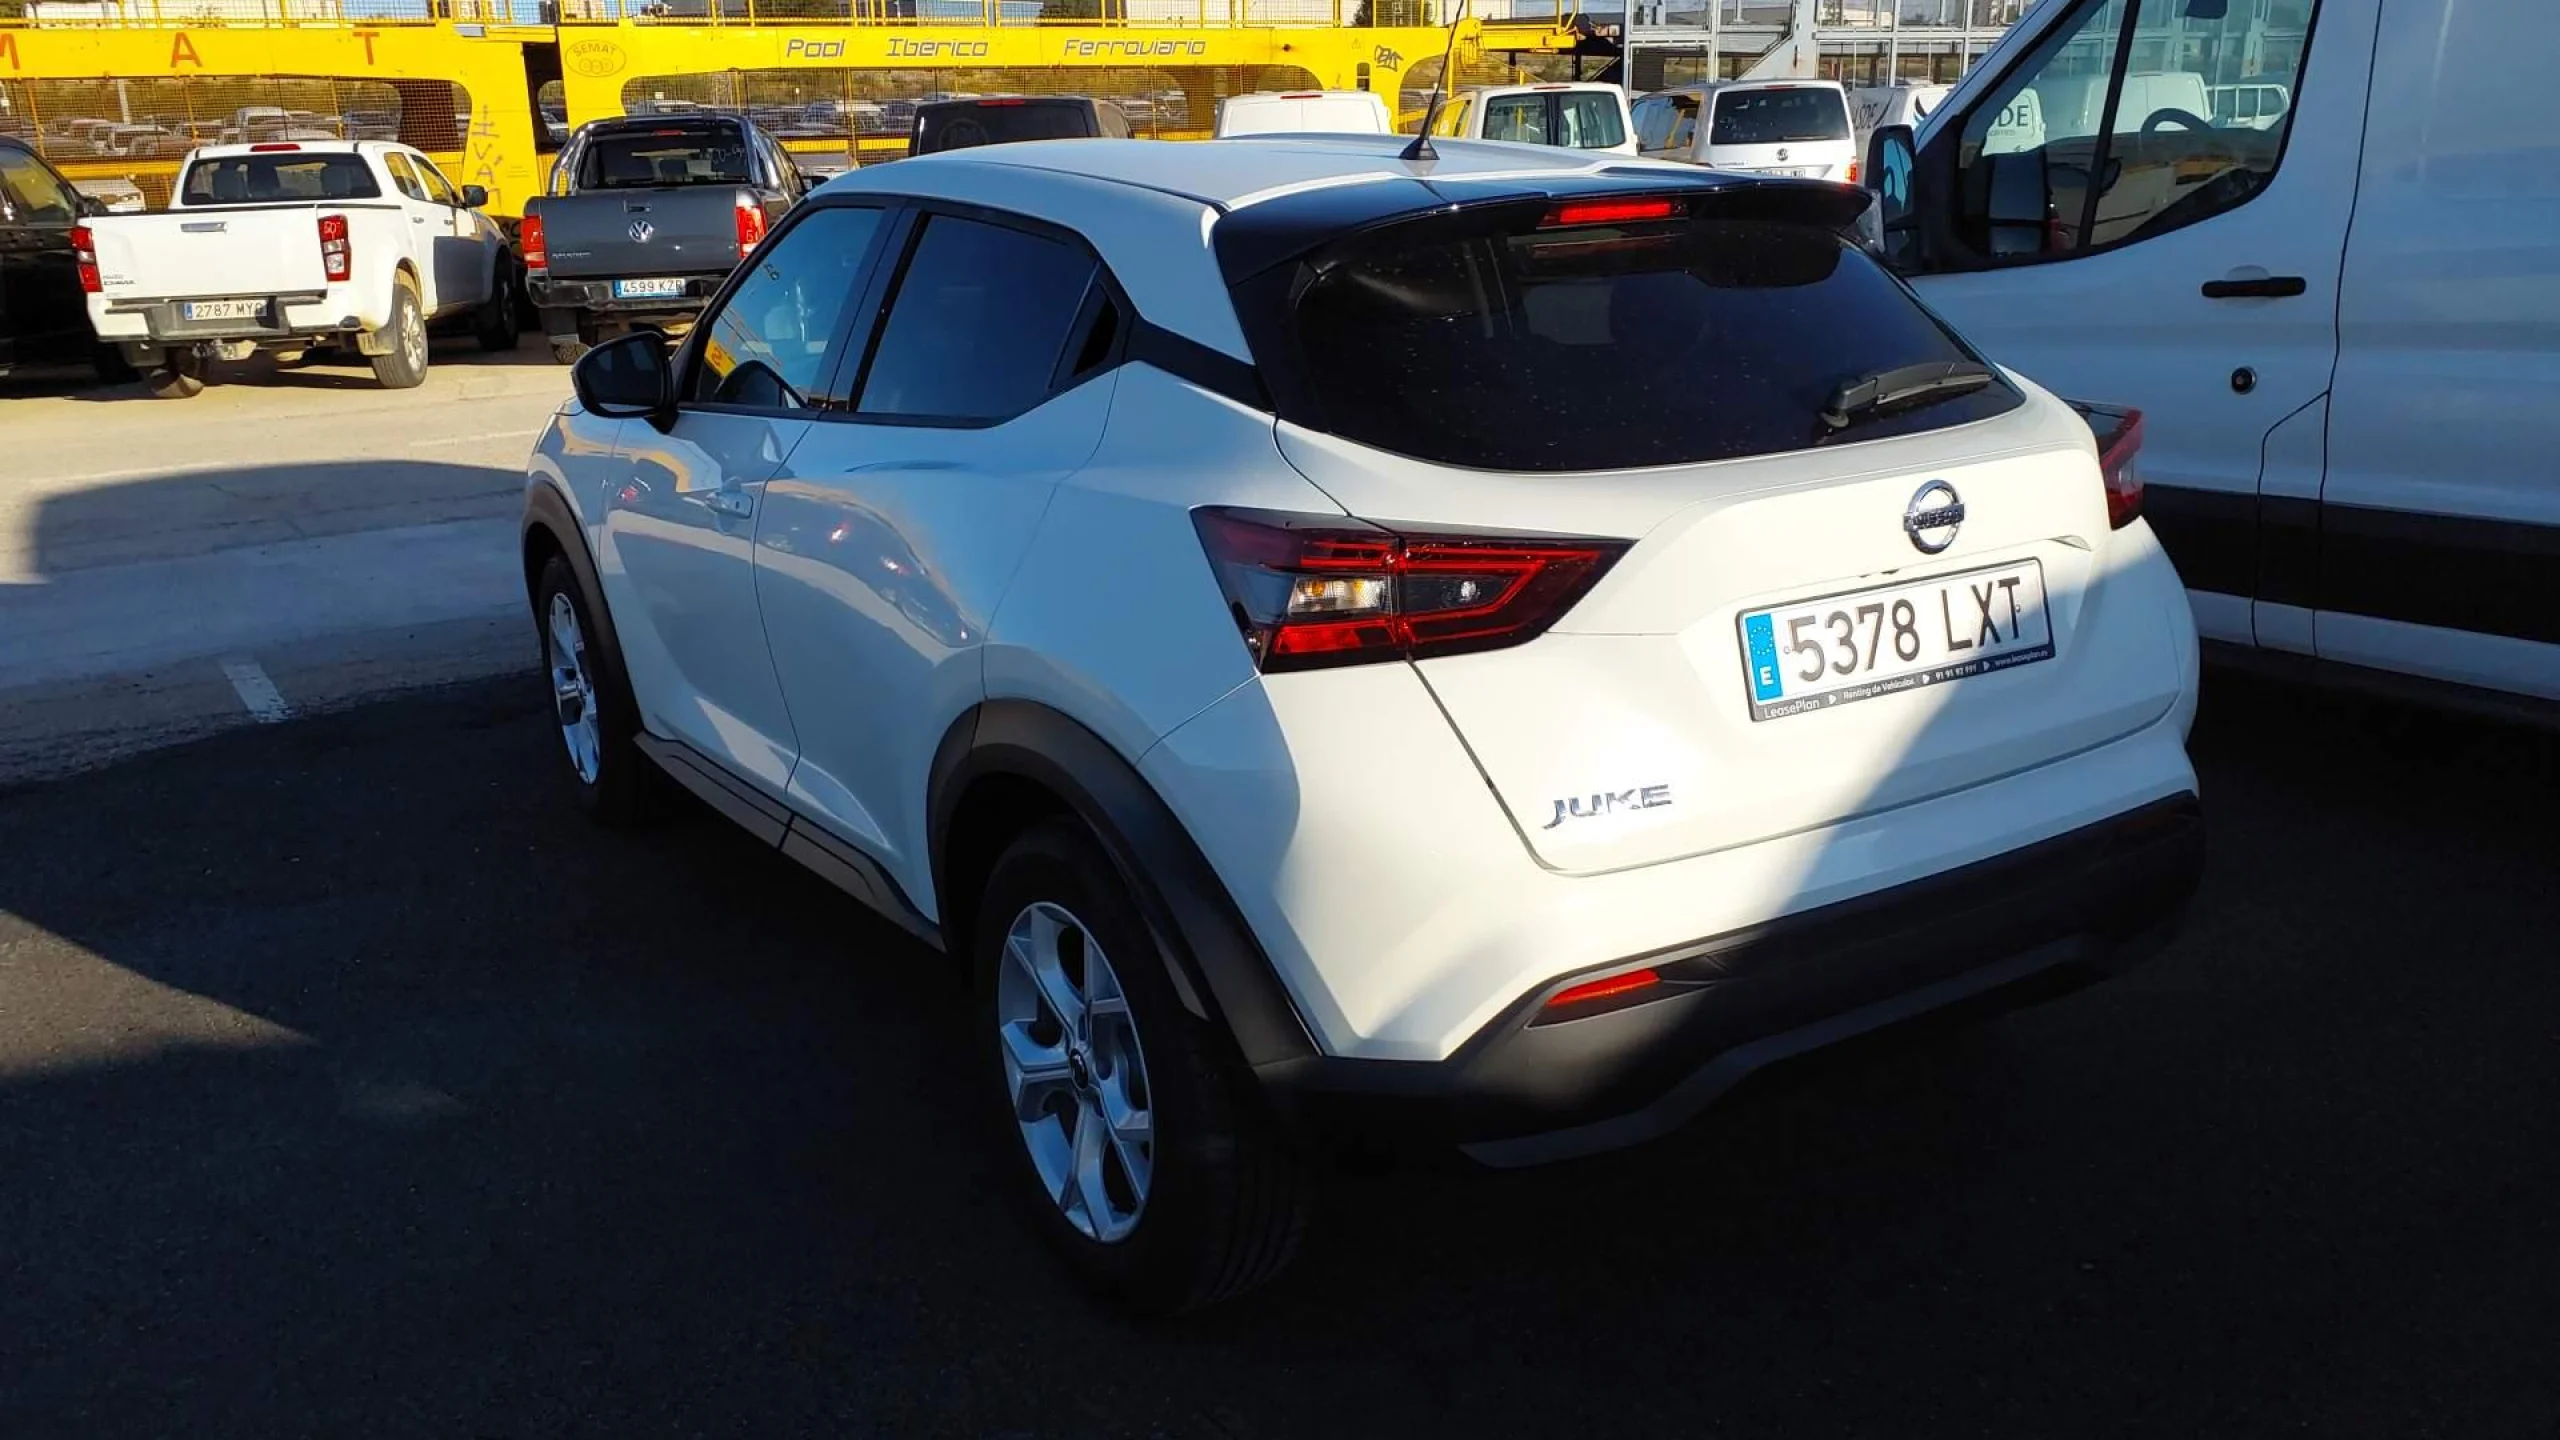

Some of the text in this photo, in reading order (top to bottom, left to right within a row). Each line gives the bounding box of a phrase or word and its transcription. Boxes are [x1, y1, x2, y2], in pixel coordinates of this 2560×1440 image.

[573, 43, 615, 57] SEMAT
[787, 40, 845, 57] Pool
[1064, 39, 1206, 56] Ferroviario
[623, 280, 654, 293] 4599
[195, 303, 230, 319] 2787
[1788, 576, 2020, 682] 5378 LXT
[1760, 667, 1774, 686] E
[1764, 697, 1820, 719] LeasePlan
[1542, 784, 1672, 829] JUKE
